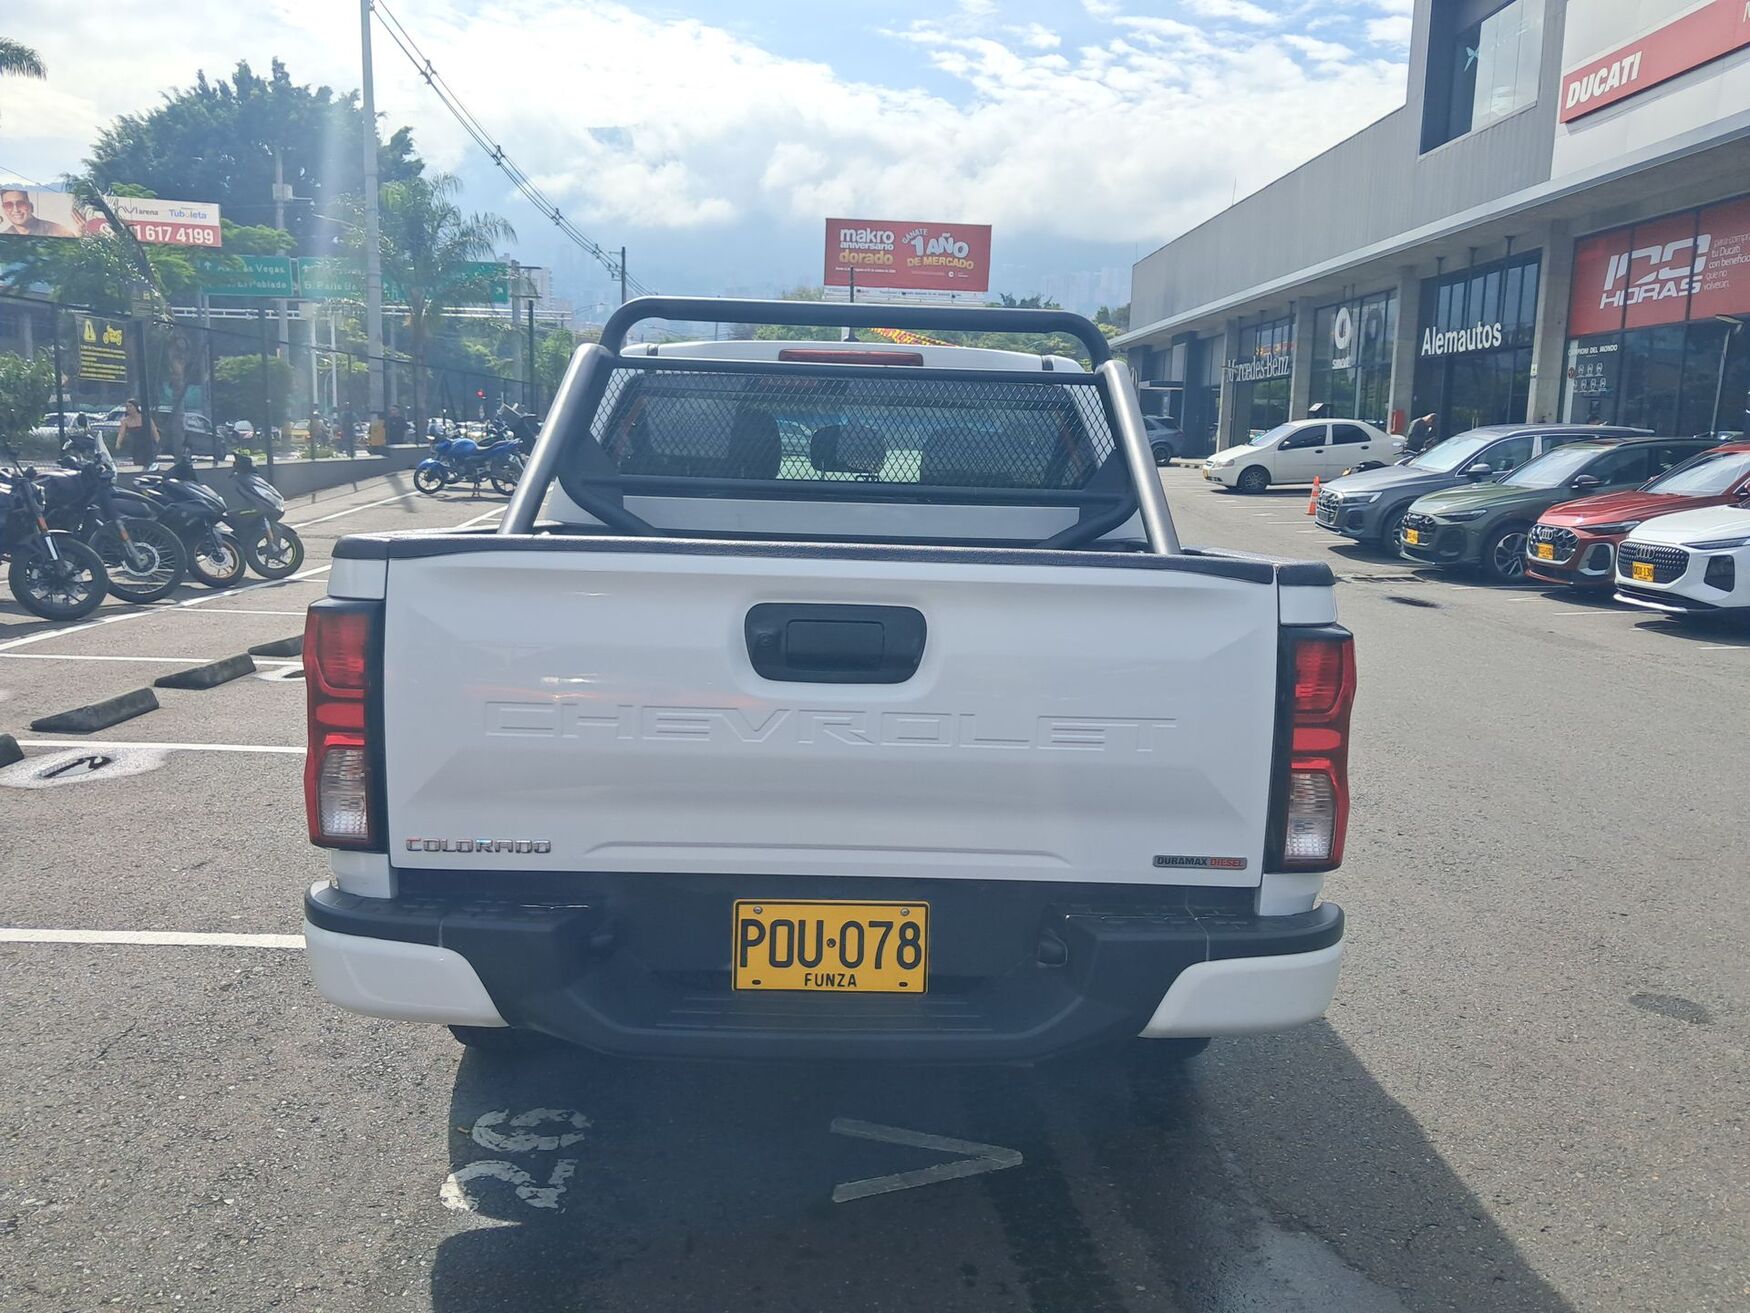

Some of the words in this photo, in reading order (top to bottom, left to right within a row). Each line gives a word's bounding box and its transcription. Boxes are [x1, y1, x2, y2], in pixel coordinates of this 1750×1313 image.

[1566, 50, 1642, 109] DUCATI
[145, 226, 172, 242] 617
[176, 228, 214, 245] 4199
[840, 228, 895, 244] makro
[840, 242, 894, 251] aniversario
[911, 235, 923, 256] 1
[926, 232, 969, 258] AÑO
[839, 249, 893, 265] dorado
[907, 257, 921, 267] DE
[923, 256, 974, 269] MERCADO
[1604, 234, 1711, 291] 100
[256, 264, 286, 274] Vegas
[1599, 275, 1703, 309] HORAS
[1421, 321, 1502, 356] Alemautos
[1590, 346, 1598, 354] DEL
[1226, 352, 1290, 383] Mercedes-Benz
[484, 700, 1177, 753] CHEVROLET
[406, 838, 551, 854] COLORADO
[1157, 856, 1207, 866] DURAMAX
[1210, 858, 1243, 867] DIESEL
[804, 972, 857, 988] FUNZA
